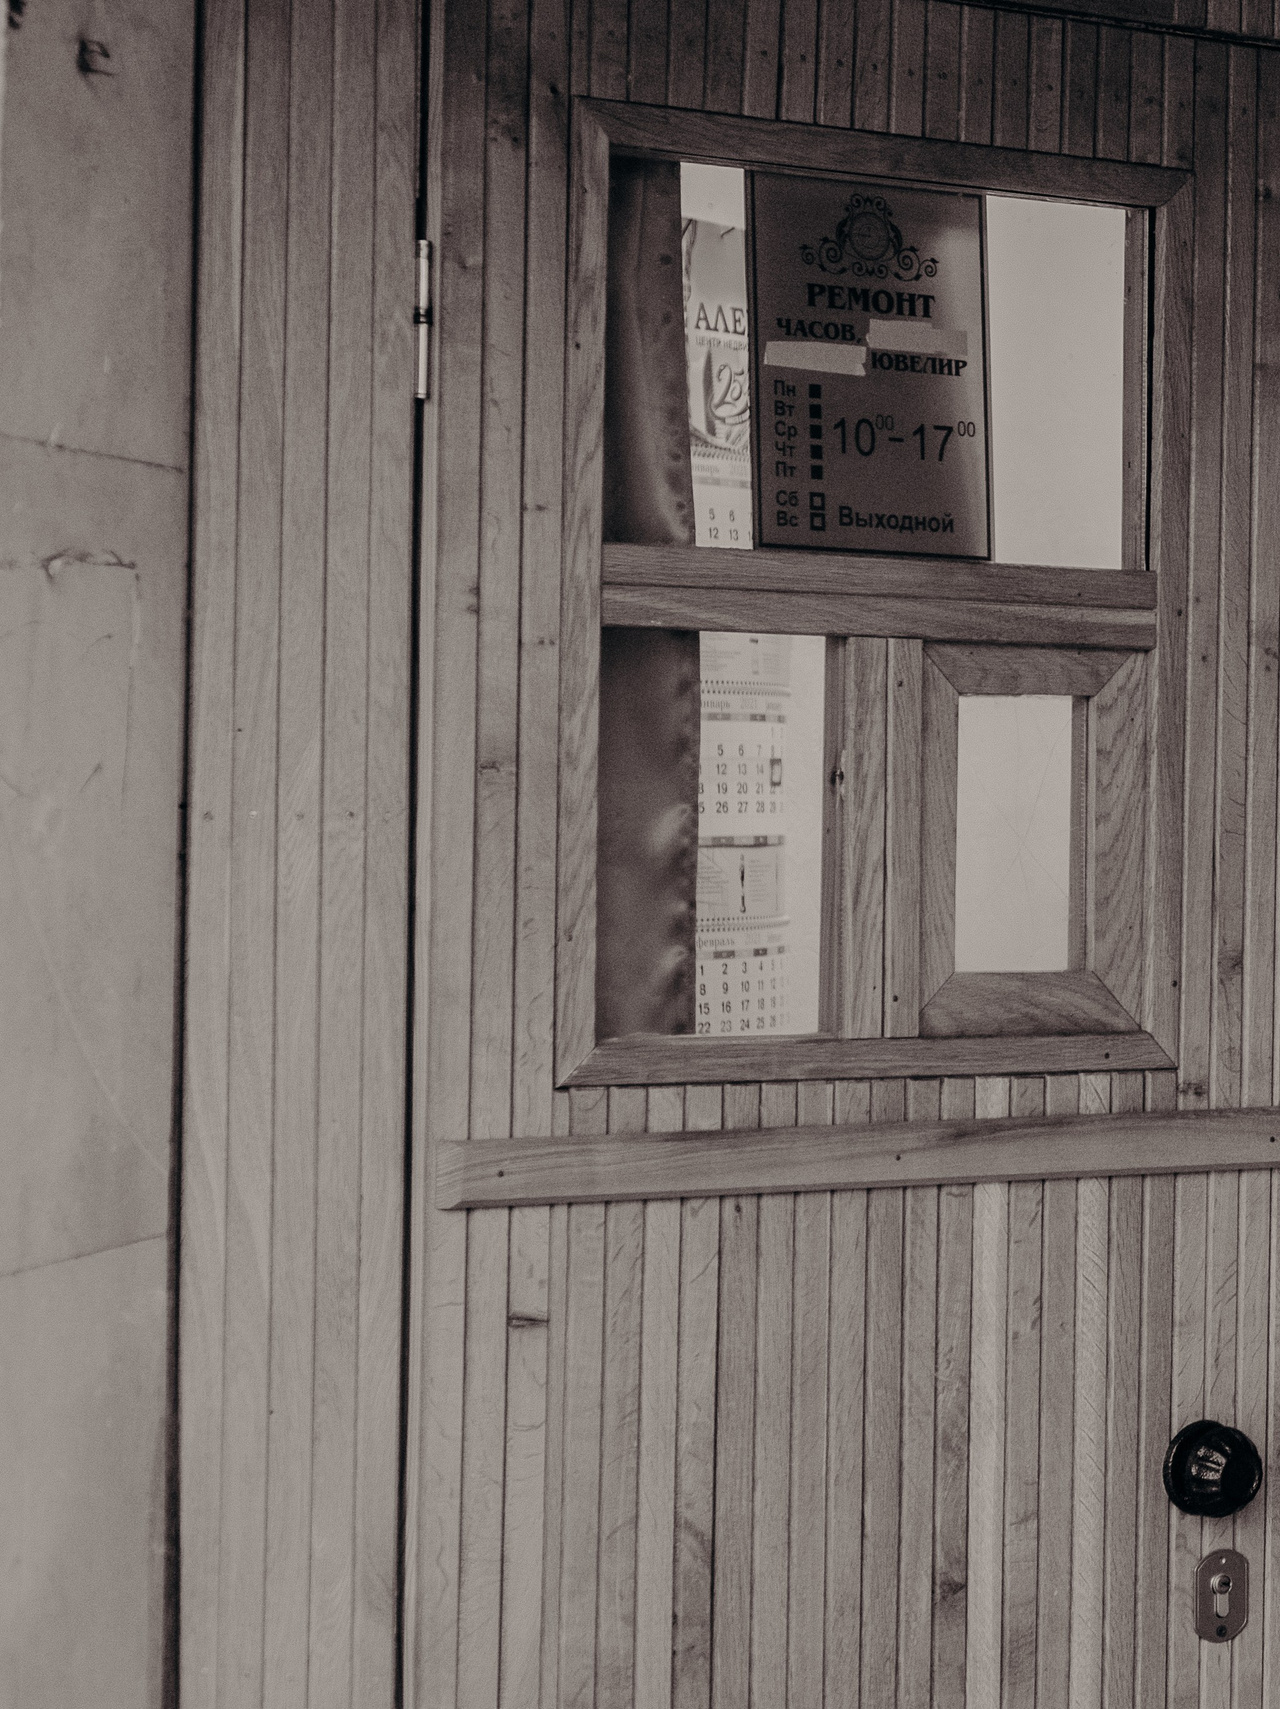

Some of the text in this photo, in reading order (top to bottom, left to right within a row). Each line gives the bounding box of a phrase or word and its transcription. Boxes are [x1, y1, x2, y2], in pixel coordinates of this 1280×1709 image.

[806, 282, 936, 318] РЕМОНТ
[776, 317, 863, 344] ЧАСОВ,
[871, 351, 968, 377] ЮВЕЛИР
[774, 379, 796, 397] Пн
[775, 400, 795, 416] Вт
[774, 420, 798, 441] Ср
[775, 441, 796, 457] Чт
[775, 461, 796, 477] Пт
[775, 490, 799, 507] Сб
[776, 510, 799, 527] Вс
[838, 505, 954, 534] Выходной
[709, 527, 719, 539] 12
[729, 529, 739, 541] 13
[717, 744, 724, 757] 5
[738, 744, 745, 757] 6
[716, 763, 727, 775] 12
[738, 763, 747, 775] 13
[717, 782, 728, 794] 19
[737, 782, 748, 794] 20
[716, 801, 728, 814] 26
[737, 801, 748, 814] 27
[756, 801, 765, 814] 28
[722, 963, 728, 975] 2
[742, 961, 748, 974] 3
[700, 983, 706, 996] 8
[722, 982, 728, 995] 9
[741, 980, 750, 992] 10
[699, 1002, 710, 1015] 15
[721, 1001, 731, 1014] 16
[741, 999, 749, 1011] 17
[698, 1022, 711, 1034] 22
[721, 1020, 732, 1033] 23
[740, 1018, 750, 1031] 24
